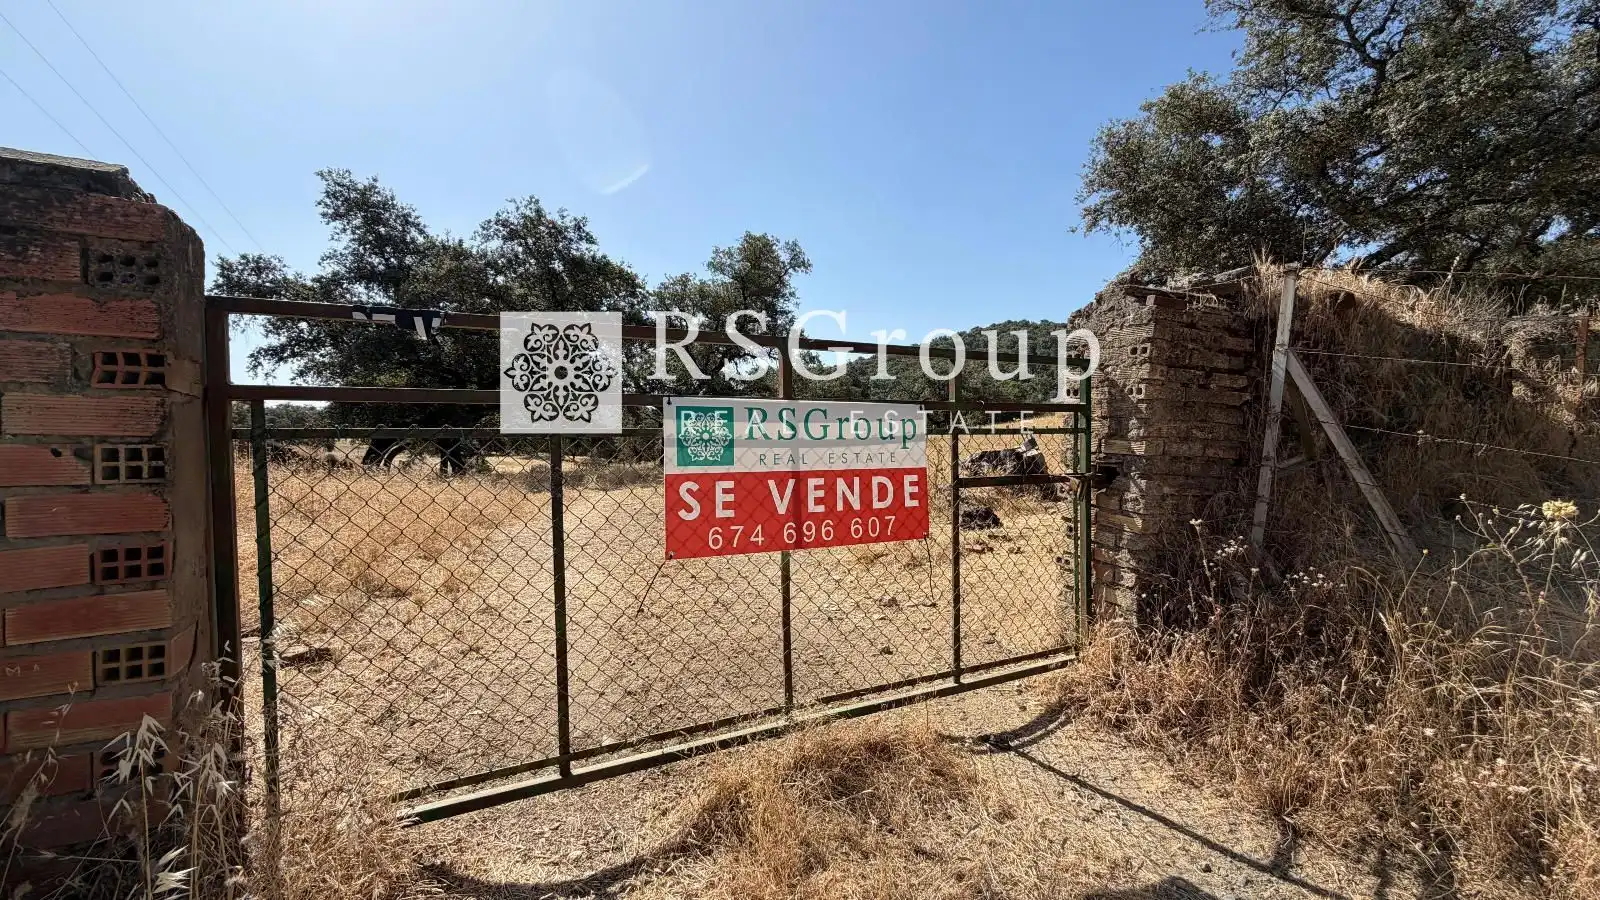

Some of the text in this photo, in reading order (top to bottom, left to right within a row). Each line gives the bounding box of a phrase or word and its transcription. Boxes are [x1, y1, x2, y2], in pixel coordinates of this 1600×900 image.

[744, 407, 917, 449] RSGroup
[759, 452, 896, 466] REAL ESTATE
[677, 475, 920, 520] SE VENDE
[708, 516, 896, 549] 674 696 607
